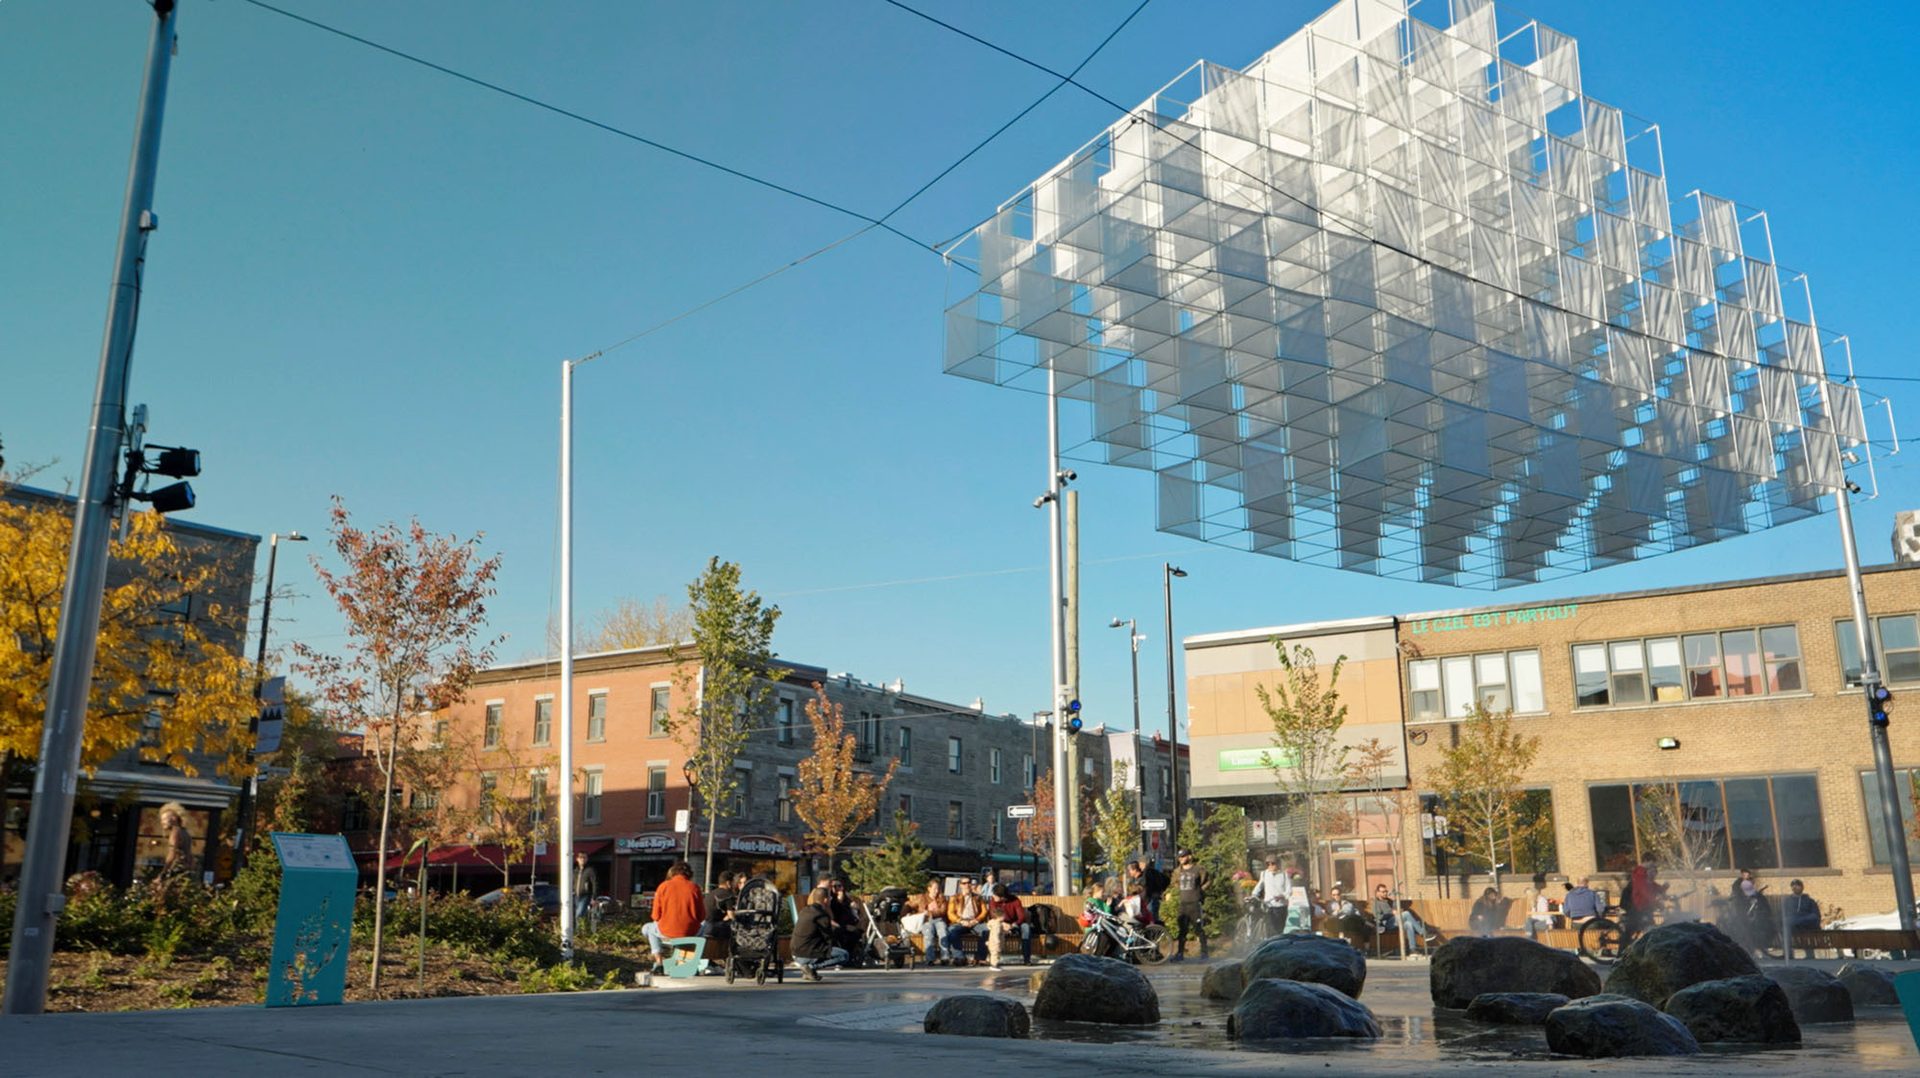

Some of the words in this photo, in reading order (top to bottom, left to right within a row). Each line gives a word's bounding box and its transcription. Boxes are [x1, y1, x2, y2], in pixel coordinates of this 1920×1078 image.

[1411, 620, 1428, 634] LE
[1472, 612, 1501, 628] EST
[1505, 604, 1579, 624] PARTOUT
[627, 837, 676, 849] Mont-Royal
[730, 838, 785, 855] Mont-Royal
